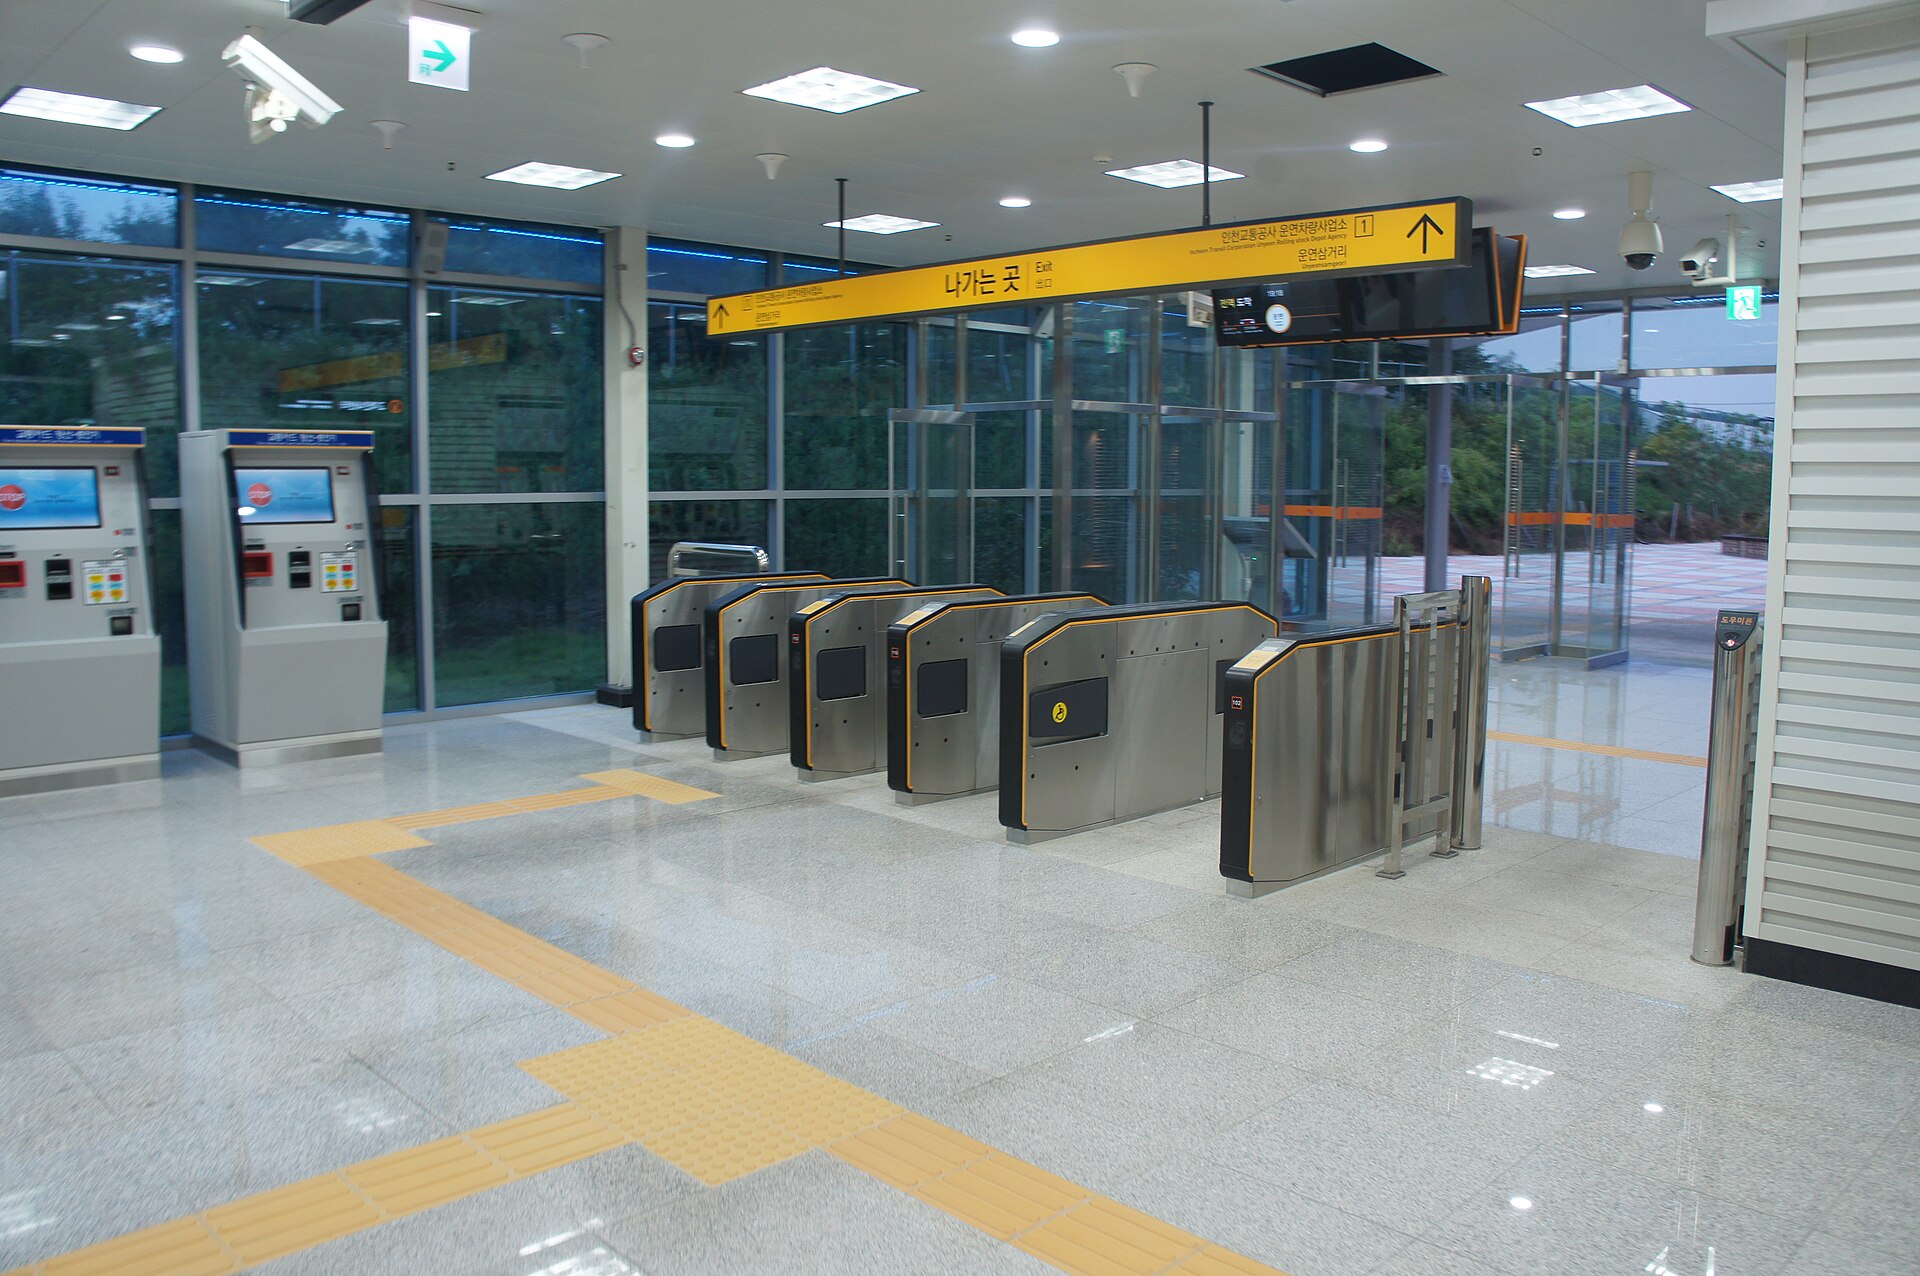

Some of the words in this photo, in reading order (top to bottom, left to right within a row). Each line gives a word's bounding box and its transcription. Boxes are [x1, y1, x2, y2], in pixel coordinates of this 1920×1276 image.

[1221, 226, 1277, 244] 인천교통공사
[1279, 218, 1348, 238] 운연차량사업소
[1327, 233, 1347, 241] Agency
[1298, 245, 1347, 262] 운연삼거리
[1035, 261, 1053, 273] Exit
[945, 269, 996, 298] 나가는
[1003, 265, 1020, 292] 곳
[1720, 616, 1753, 625] 도우미폰
